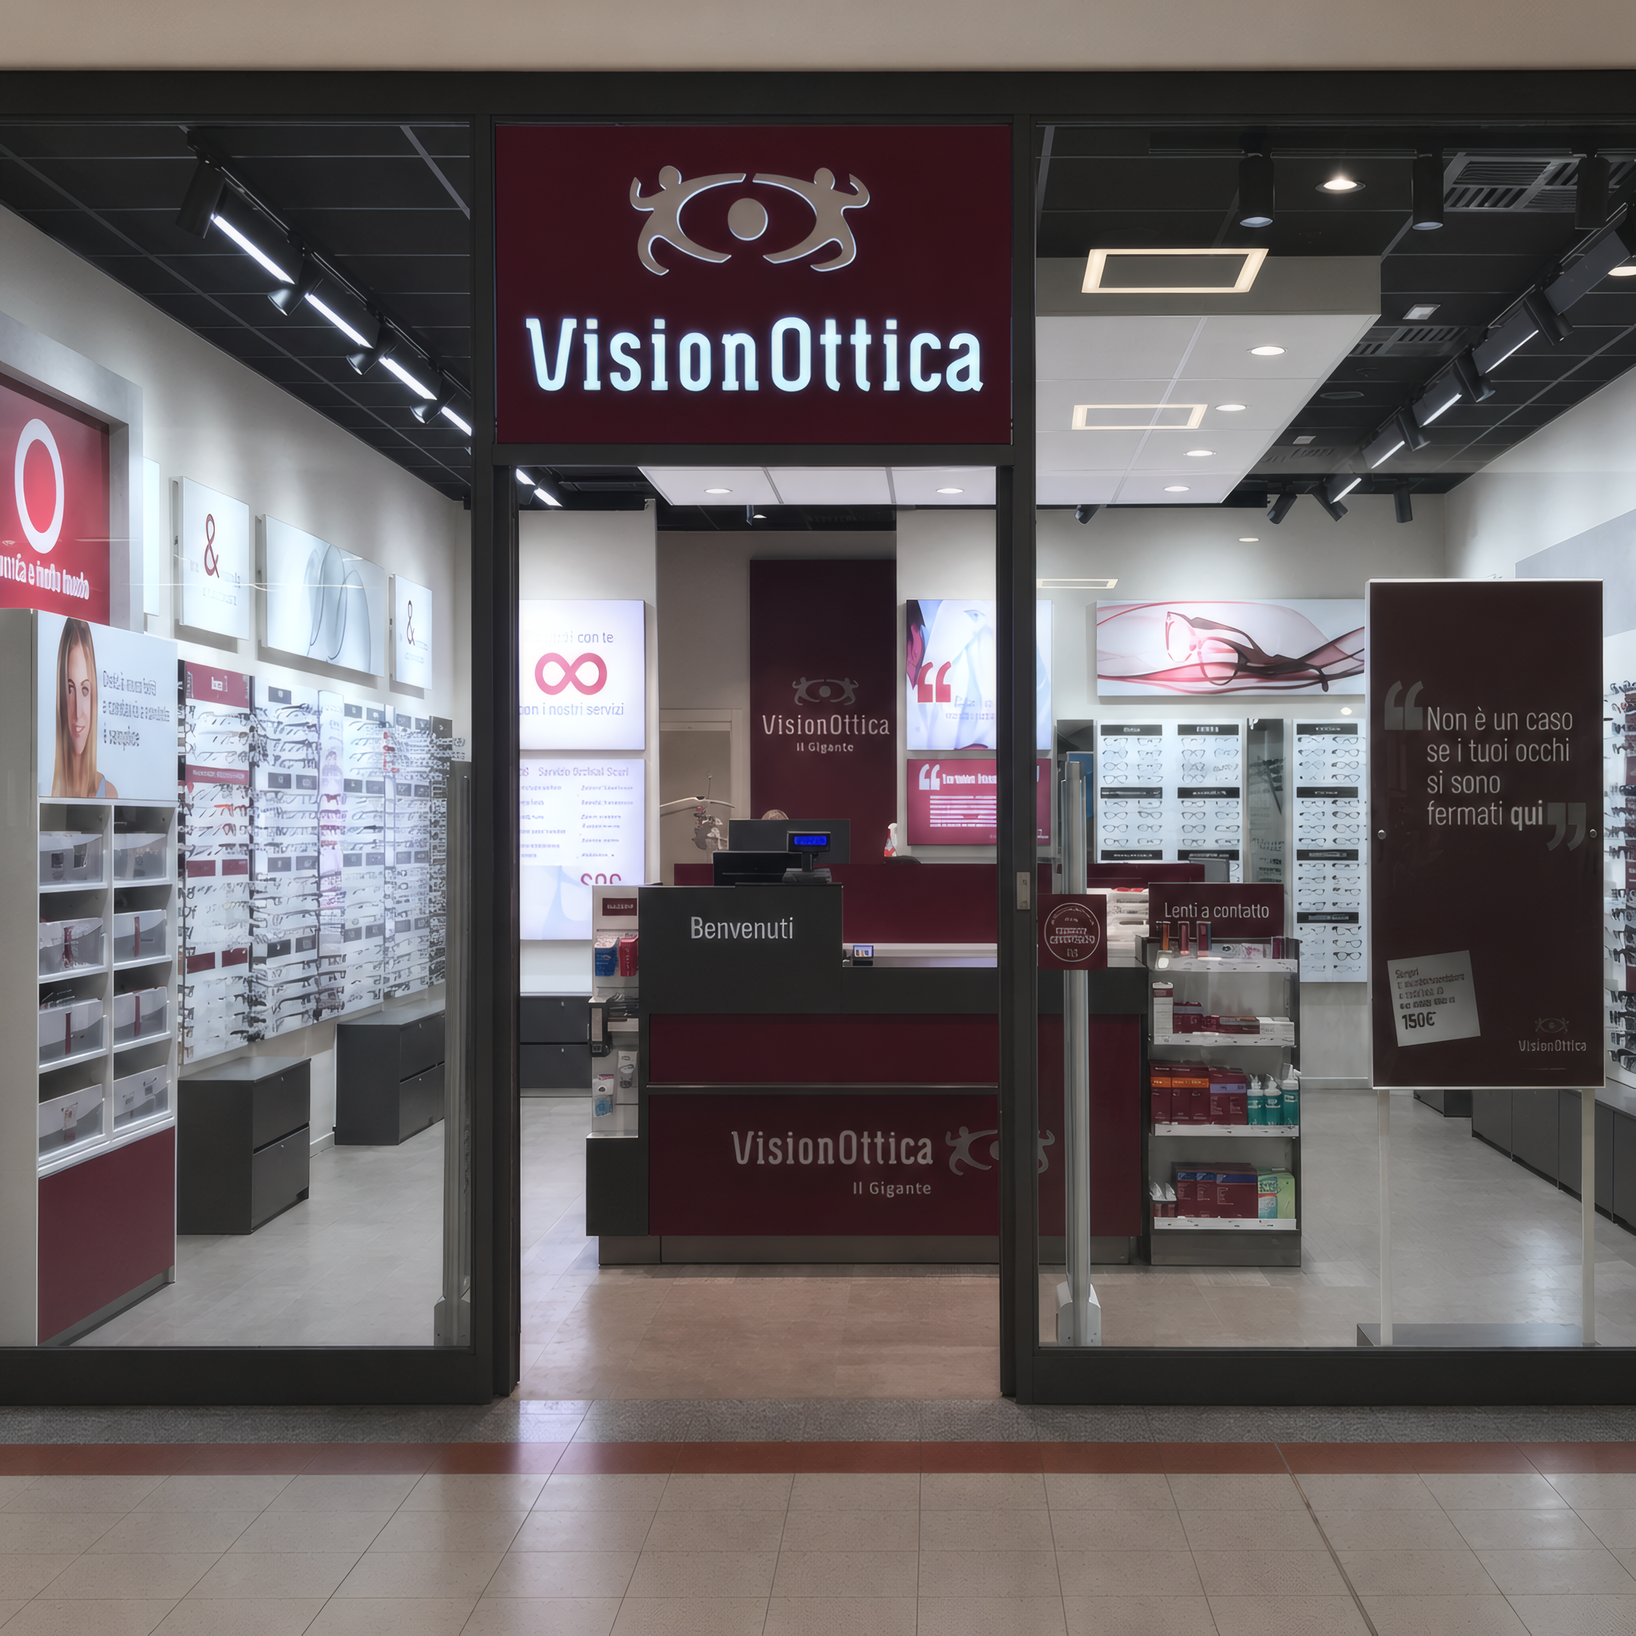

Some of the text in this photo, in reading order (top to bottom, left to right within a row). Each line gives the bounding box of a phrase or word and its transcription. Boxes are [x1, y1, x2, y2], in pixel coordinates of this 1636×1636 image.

[525, 316, 984, 393] VisionOttica
[577, 633, 599, 643] con
[602, 632, 614, 643] te
[542, 702, 546, 716] i
[549, 702, 583, 716] nostri
[586, 702, 624, 716] servizi
[1427, 706, 1573, 731] Non è un caso
[762, 714, 890, 735] VisionOttica
[808, 742, 854, 754] Gigante
[1427, 737, 1570, 762] se i tuoi occhi
[1427, 770, 1501, 794] si sono
[1427, 800, 1543, 831] fermati qui
[1164, 902, 1270, 918] Lenti a contatto
[690, 916, 793, 940] Benvenuti
[1402, 1011, 1437, 1030] 150€
[1518, 1038, 1587, 1052] VisionOttica
[731, 1130, 934, 1165] VisionOttica
[853, 1181, 932, 1198] Il Gigante
